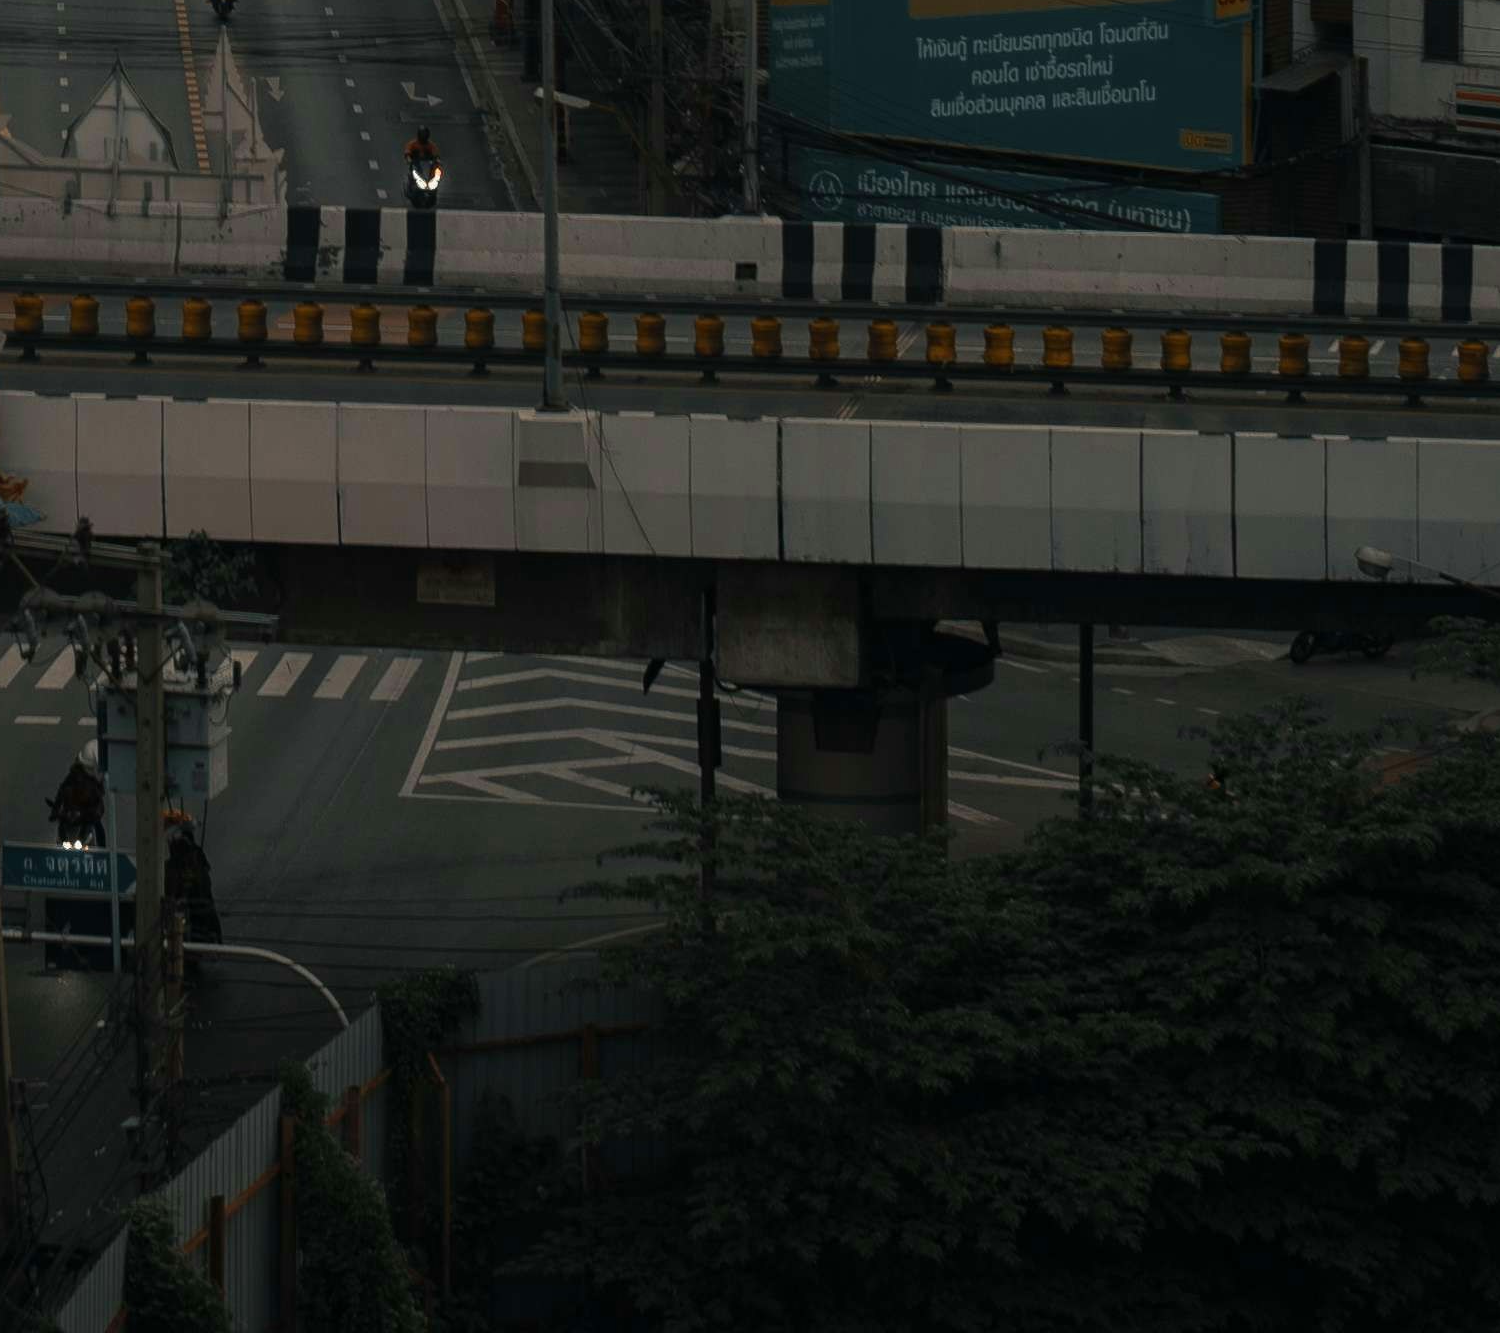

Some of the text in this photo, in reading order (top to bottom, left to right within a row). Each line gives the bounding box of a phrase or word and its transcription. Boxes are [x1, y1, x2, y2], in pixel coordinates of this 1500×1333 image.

[914, 17, 1169, 62] ให้เงินกู้ ทะเบียนรถทุกชนิด โฉนดที่ดิน
[970, 53, 1114, 86] คอนโด เช่าซื้อรถใหม่
[930, 79, 1157, 118] สินเชื่อส่วนบุคคล และสินเชื่อนาโน
